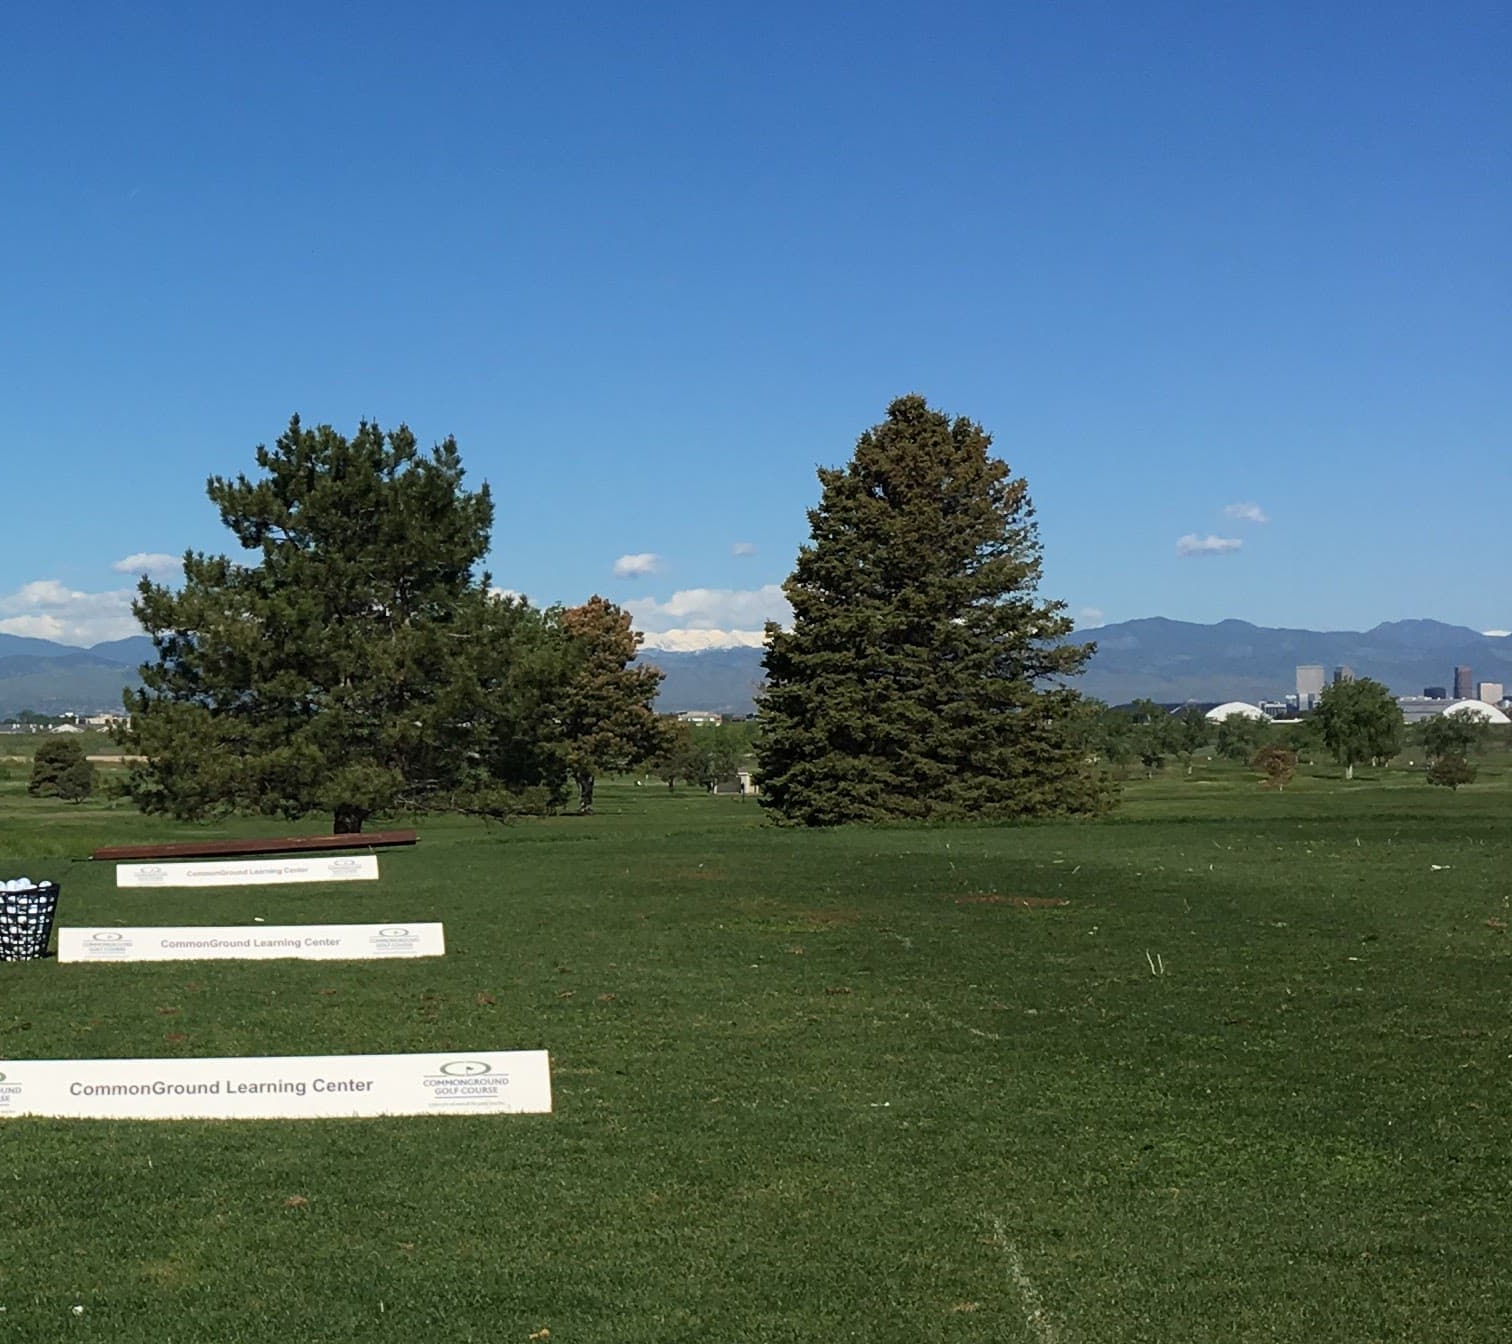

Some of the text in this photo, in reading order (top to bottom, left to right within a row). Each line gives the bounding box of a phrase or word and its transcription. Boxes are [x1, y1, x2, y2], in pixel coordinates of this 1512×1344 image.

[249, 866, 283, 876] Learning
[284, 865, 308, 874] Center
[160, 937, 342, 949] CommonGround Learning Center
[69, 1077, 374, 1097] CommonGround Learning Center
[423, 1078, 509, 1087] COMMONGROUND
[434, 1086, 498, 1095] GOLF COURSE
